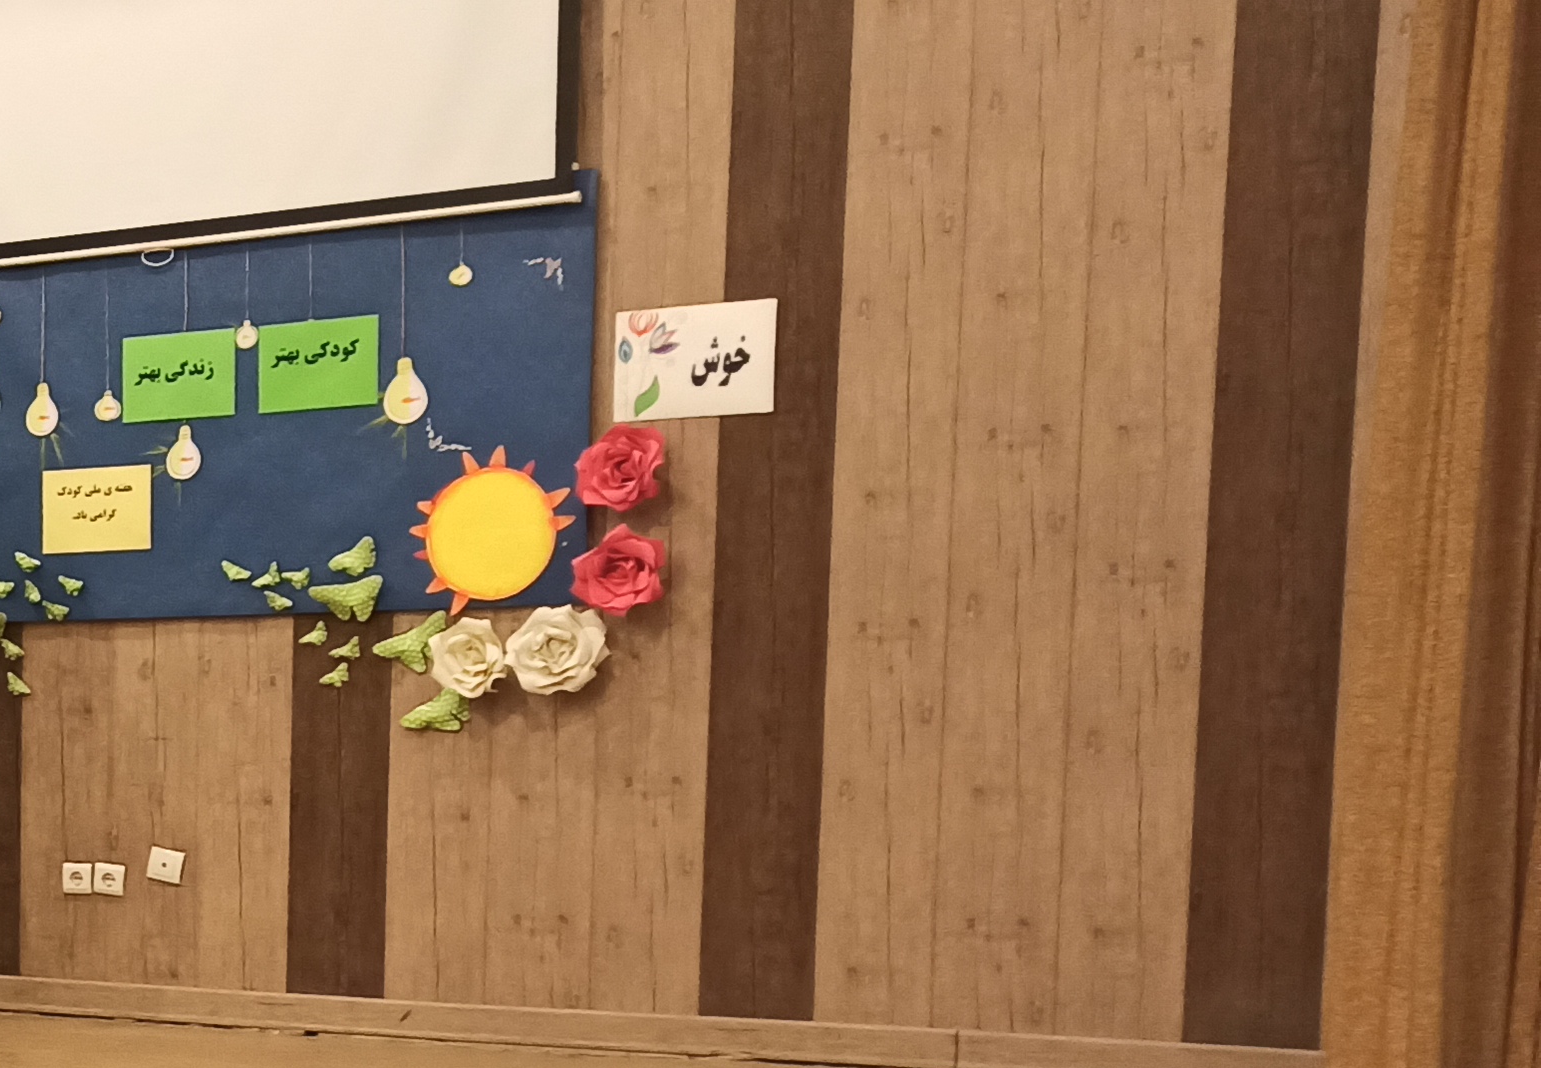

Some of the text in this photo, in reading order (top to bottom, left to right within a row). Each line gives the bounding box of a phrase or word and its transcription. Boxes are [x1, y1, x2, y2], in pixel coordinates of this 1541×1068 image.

[271, 338, 360, 369] کودکی بهتر
[690, 335, 751, 387] خوش
[134, 358, 215, 387] زندگی بهتر
[57, 485, 83, 499] کودک
[84, 484, 101, 497] ملی
